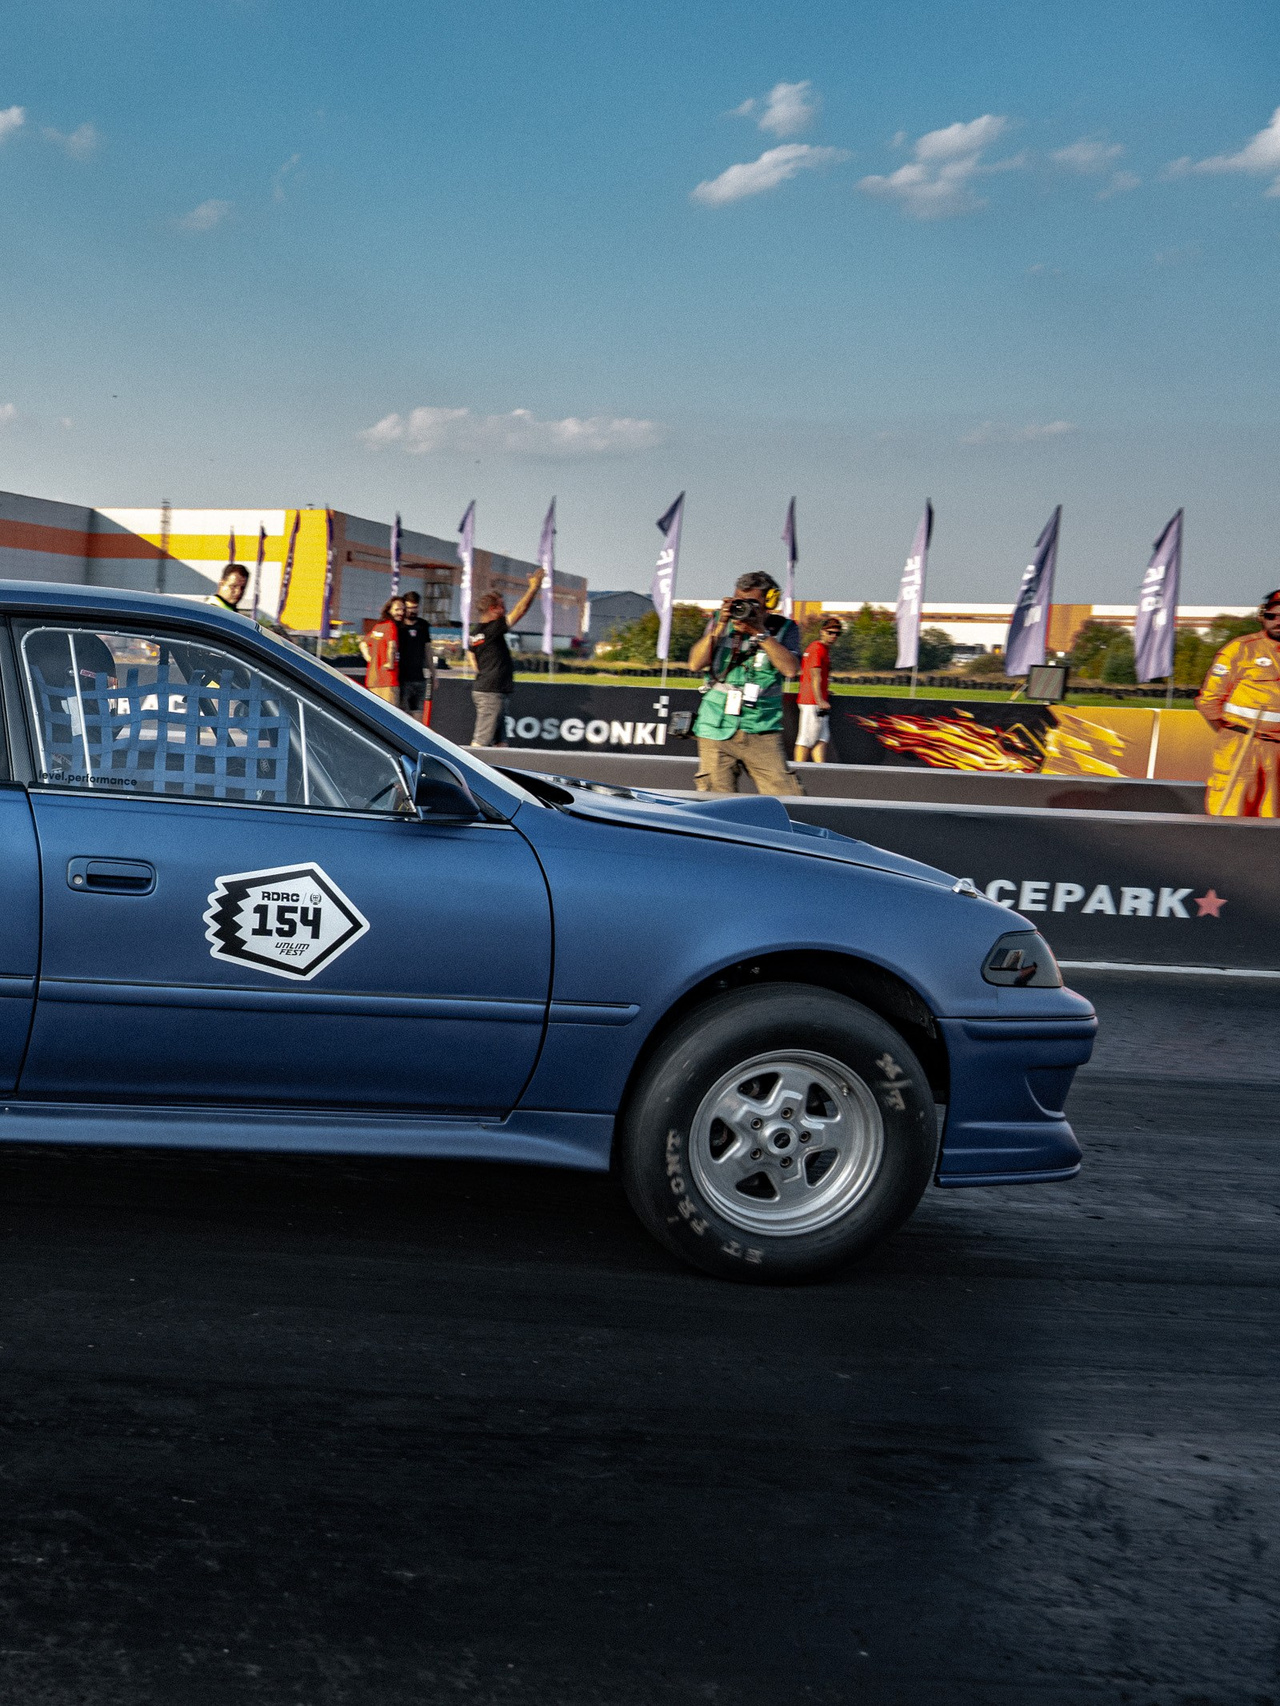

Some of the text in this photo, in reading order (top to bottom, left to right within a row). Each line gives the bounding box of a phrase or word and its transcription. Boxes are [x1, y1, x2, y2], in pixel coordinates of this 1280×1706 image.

[503, 716, 668, 745] ROSGONKI
[261, 891, 300, 903] RDRC
[251, 904, 322, 940] 154
